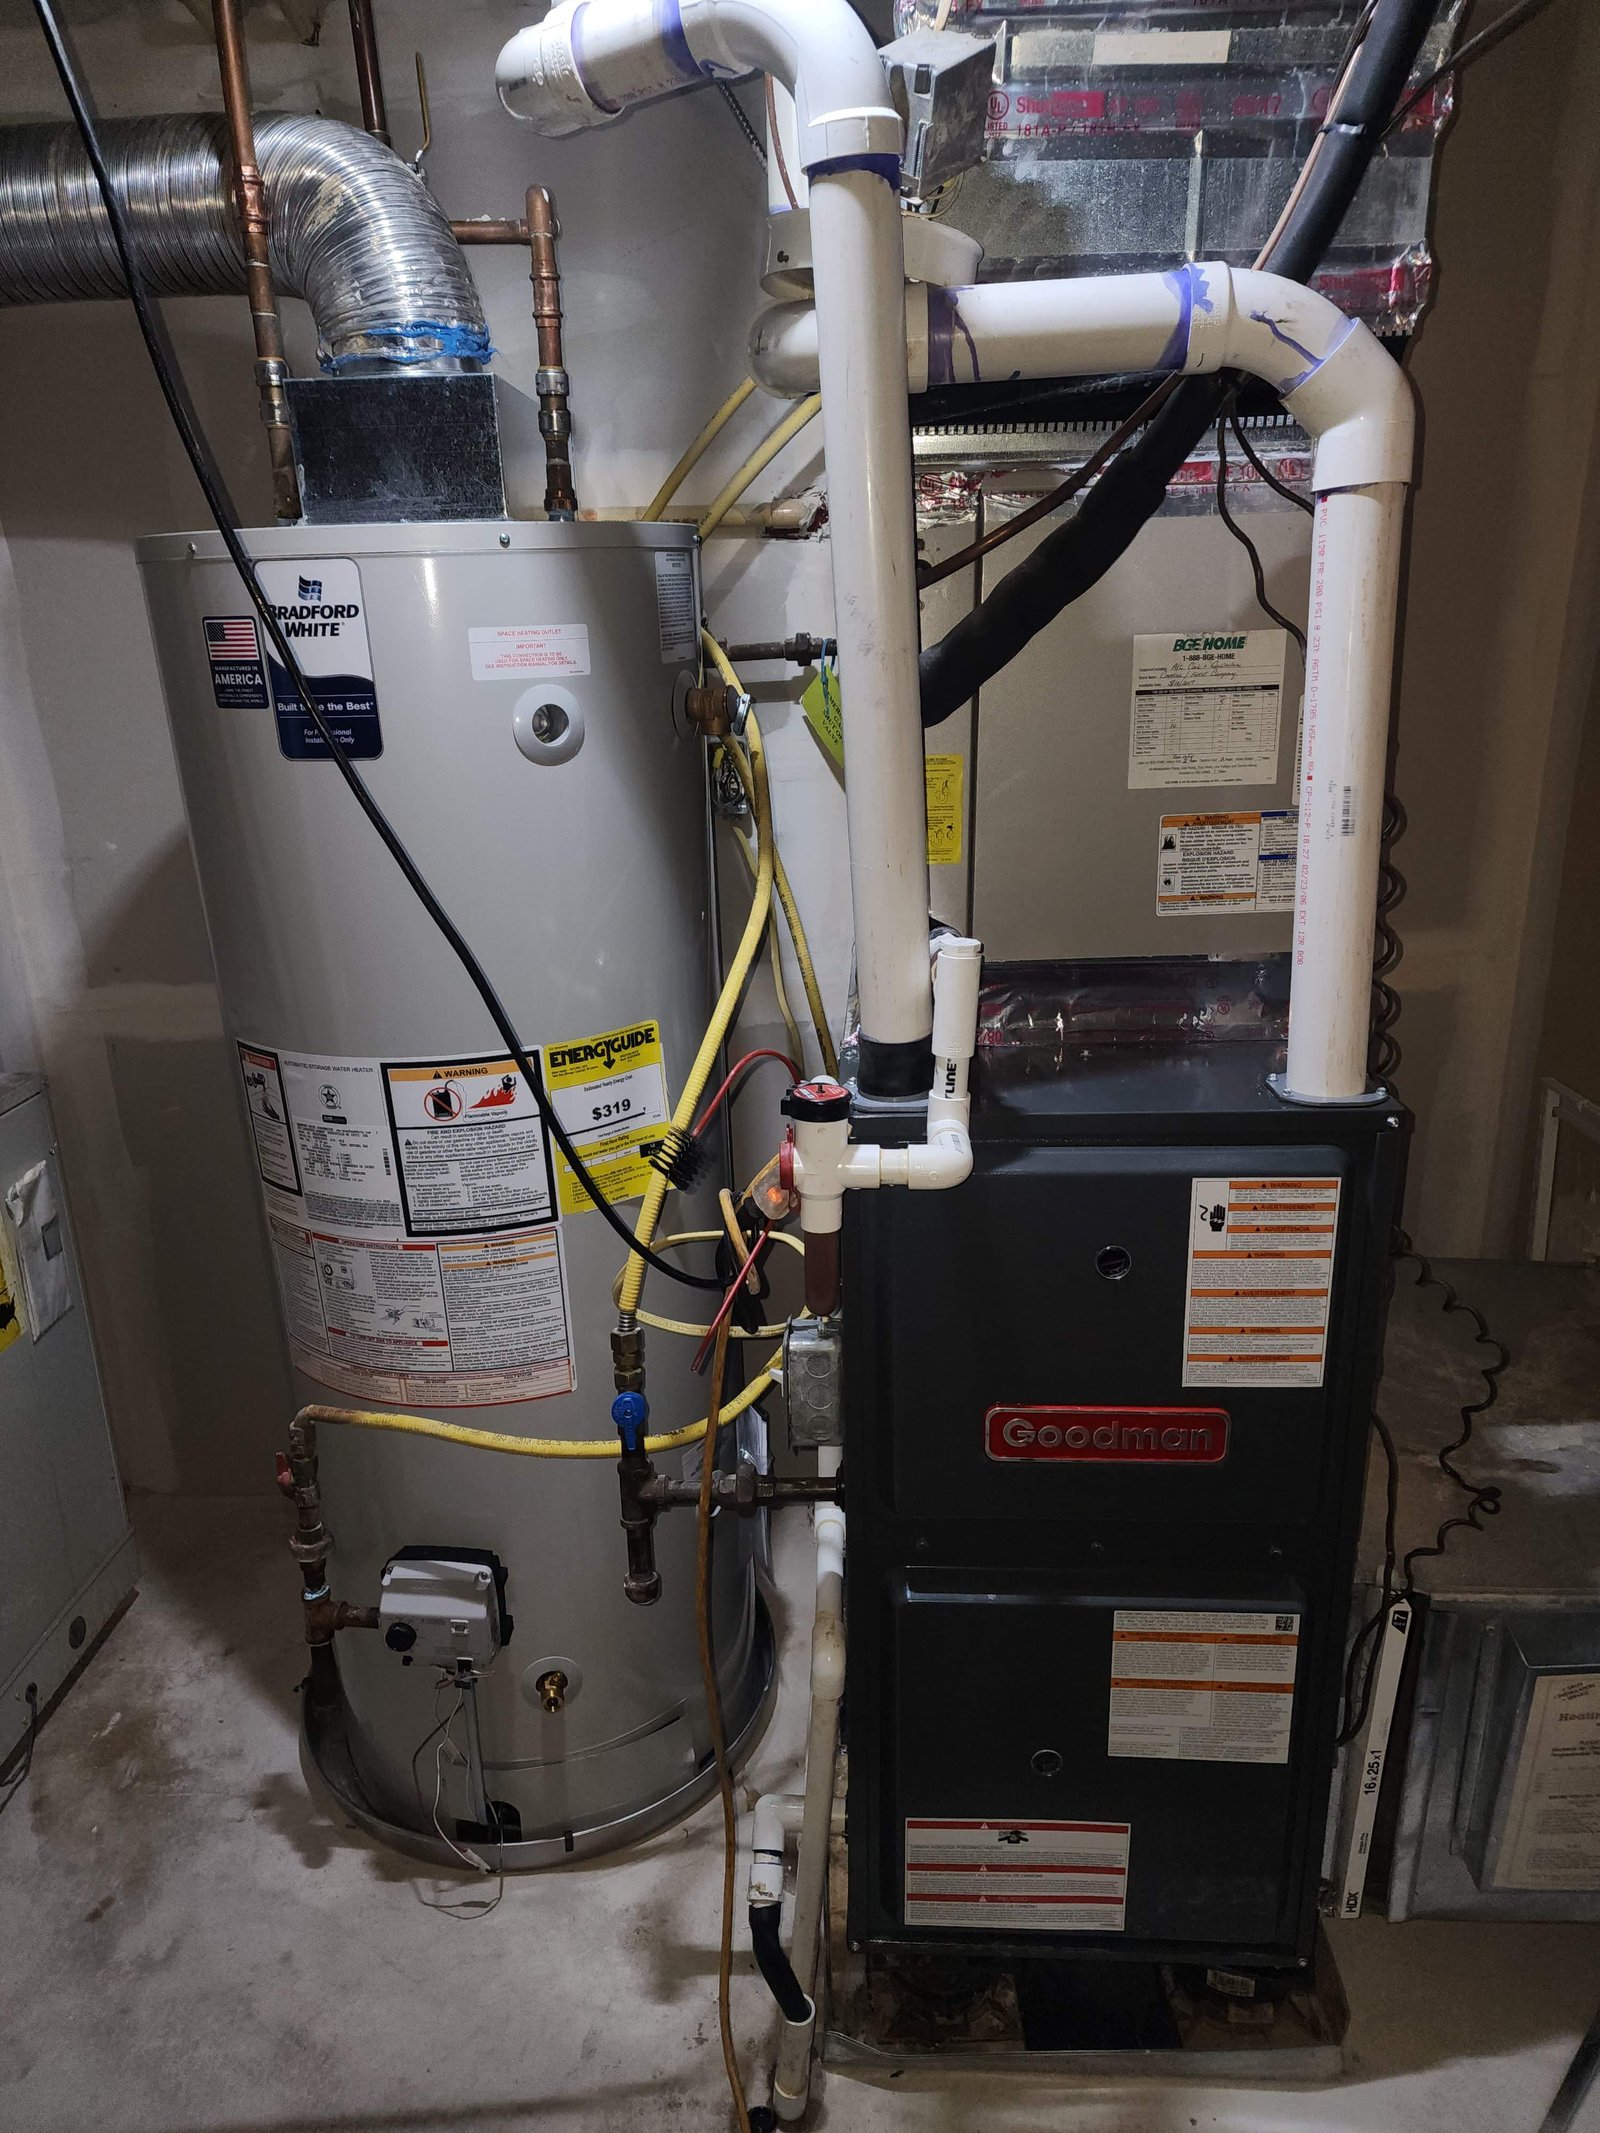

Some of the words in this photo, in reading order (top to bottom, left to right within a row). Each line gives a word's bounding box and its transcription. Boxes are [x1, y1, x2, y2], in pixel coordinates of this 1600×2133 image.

[269, 605, 359, 620] BRADFORD
[285, 622, 339, 637] WHITE
[1173, 639, 1203, 652] BGE
[1202, 636, 1247, 650] HOME
[1182, 653, 1236, 661] 1-888-BGE-HOME
[215, 674, 263, 685] AMERICA
[278, 703, 297, 711] Built
[327, 702, 343, 710] the
[347, 702, 369, 710] Best
[549, 1027, 656, 1070] ENERGYGUIDE
[284, 1061, 308, 1069] AUTOMATIC
[309, 1063, 332, 1071] STORAGE
[444, 1067, 488, 1077] WARNING
[584, 1084, 601, 1092] Estimated
[592, 1099, 631, 1121] $319
[452, 1126, 483, 1134] EXPLOSION
[1003, 1417, 1212, 1451] Goodman
[1364, 1749, 1383, 1796] 16x25x1
[1346, 1891, 1359, 1913] HDX
